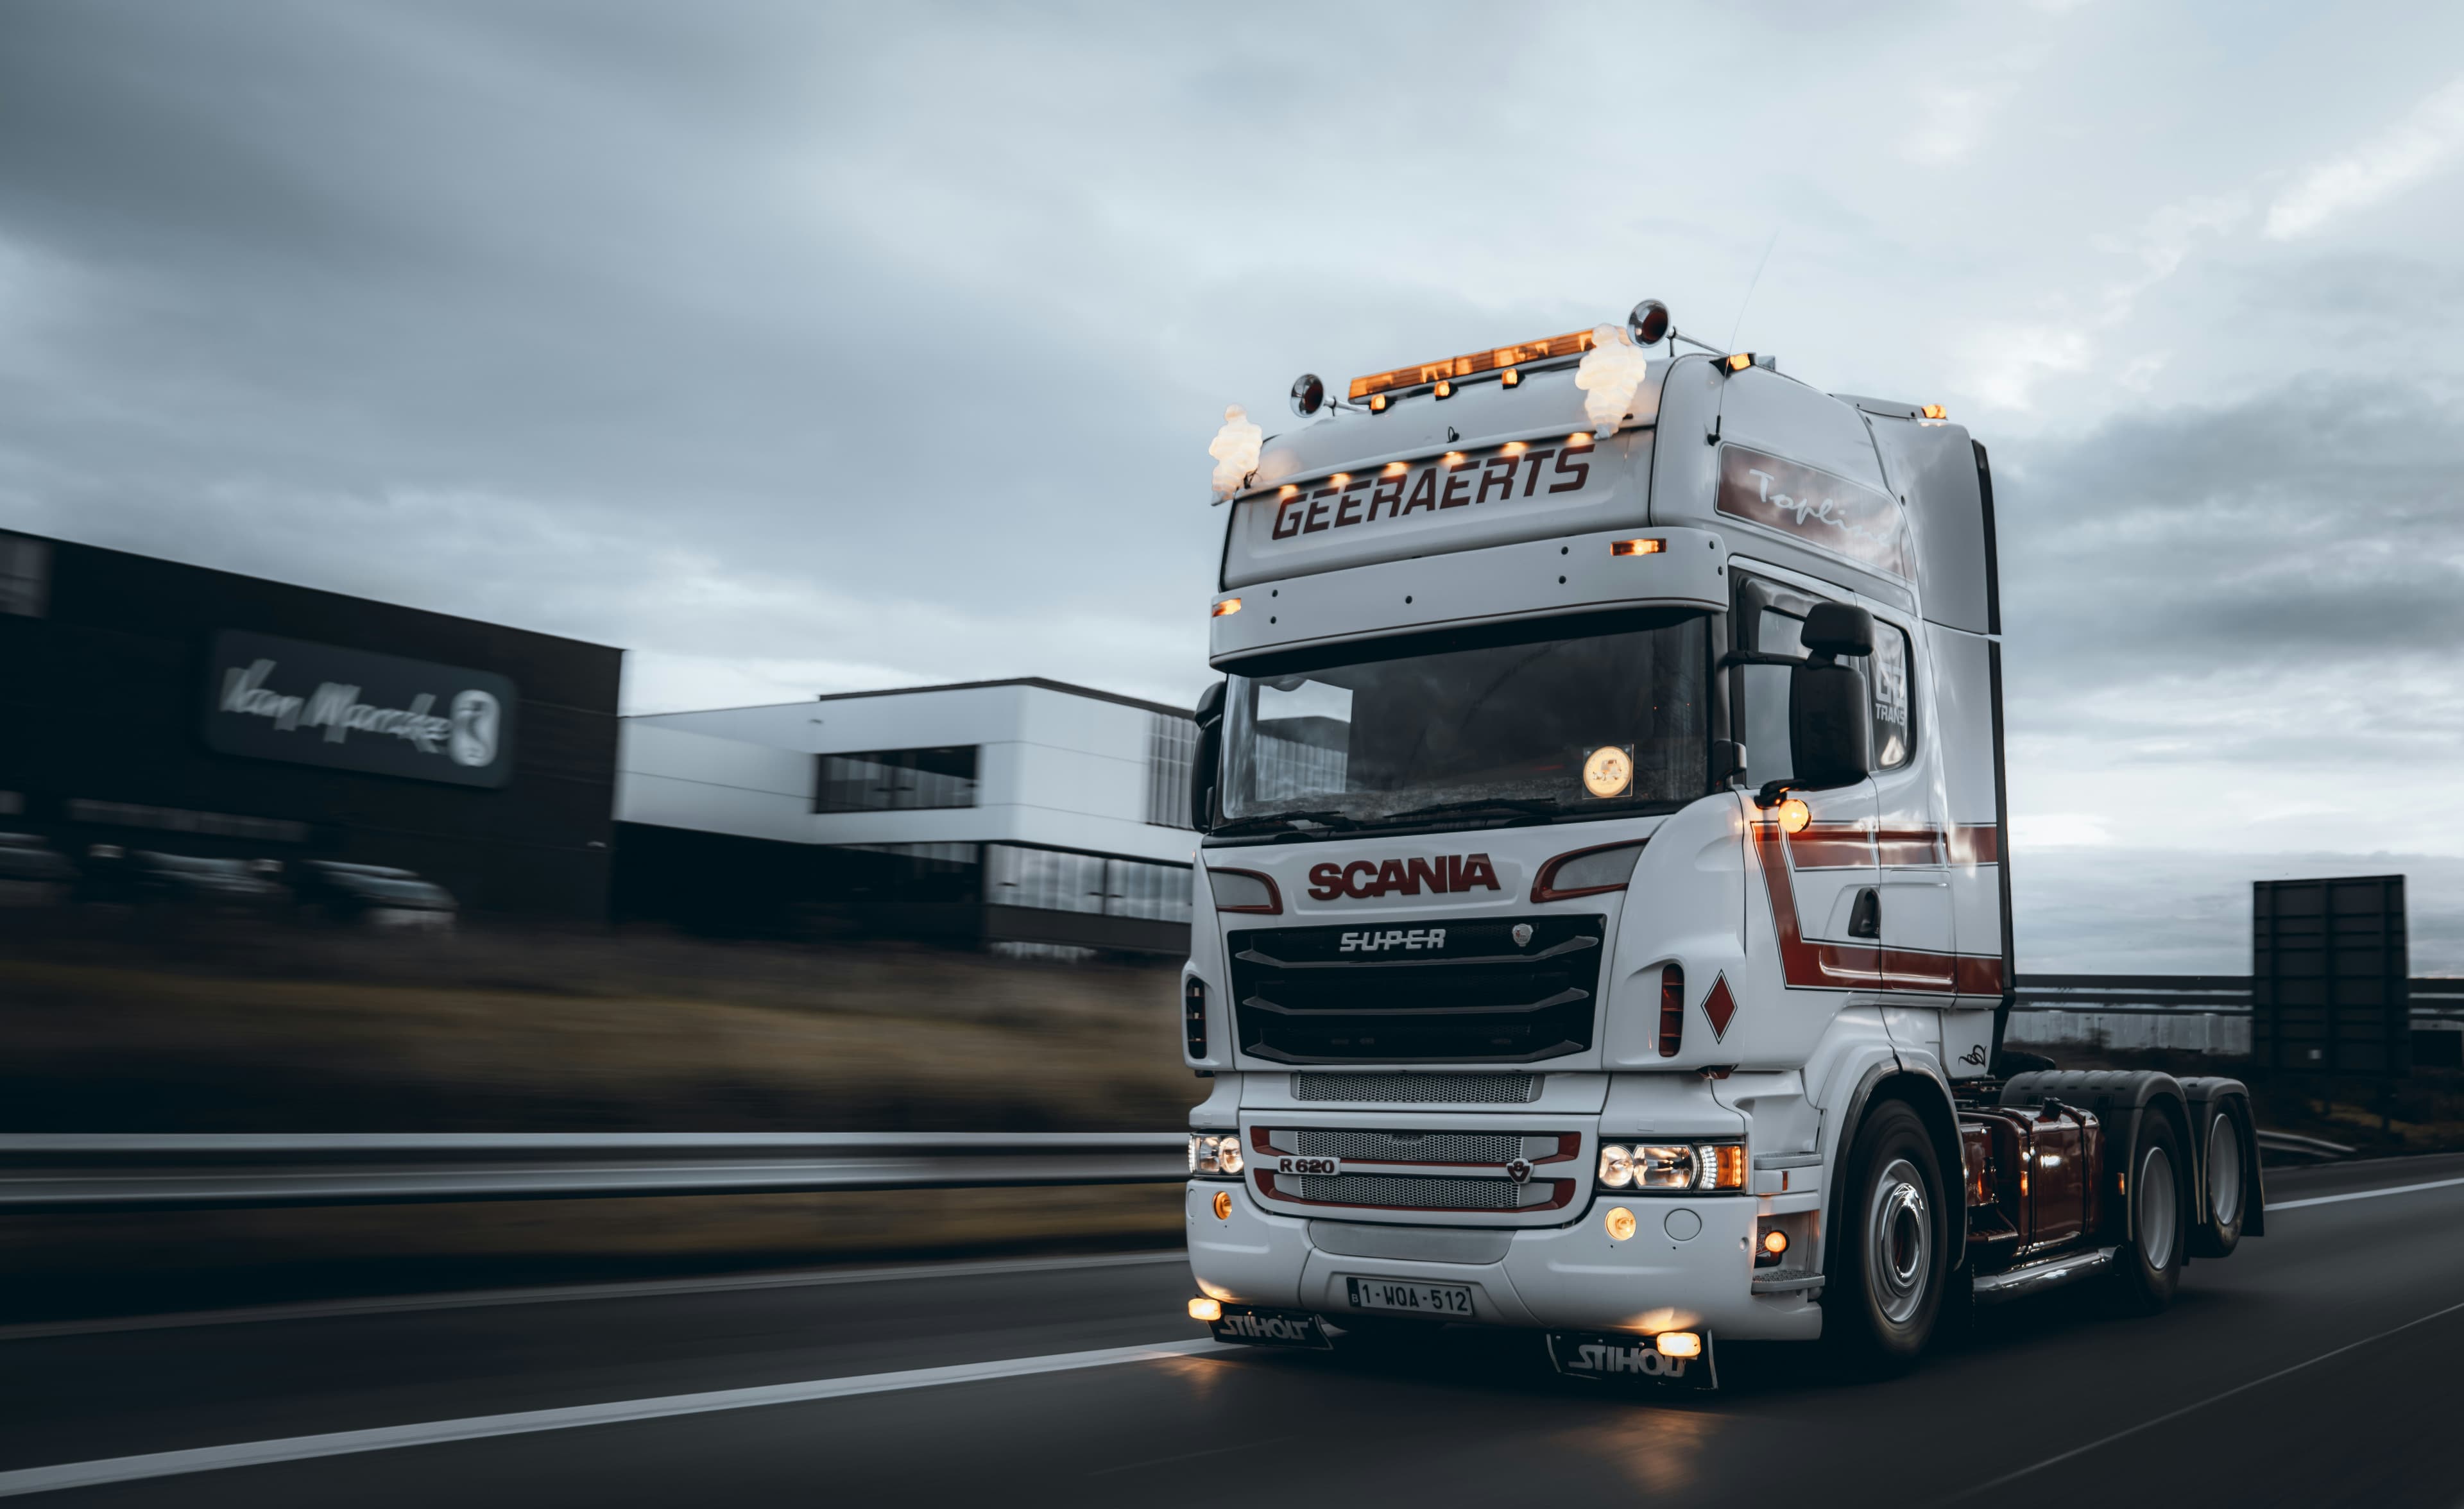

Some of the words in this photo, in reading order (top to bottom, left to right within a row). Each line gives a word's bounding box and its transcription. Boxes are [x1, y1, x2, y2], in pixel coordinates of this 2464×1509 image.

[1272, 444, 1595, 540] GEERAERTS
[1876, 703, 1904, 726] TRANS
[1308, 853, 1501, 901] SCANIA
[1340, 929, 1446, 952] SUPER
[1280, 1158, 1293, 1172] R
[1296, 1159, 1335, 1174] 620
[1351, 1293, 1358, 1302] B
[1362, 1284, 1468, 1311] 1-WQA-512
[1219, 1315, 1309, 1340] STIHOLT
